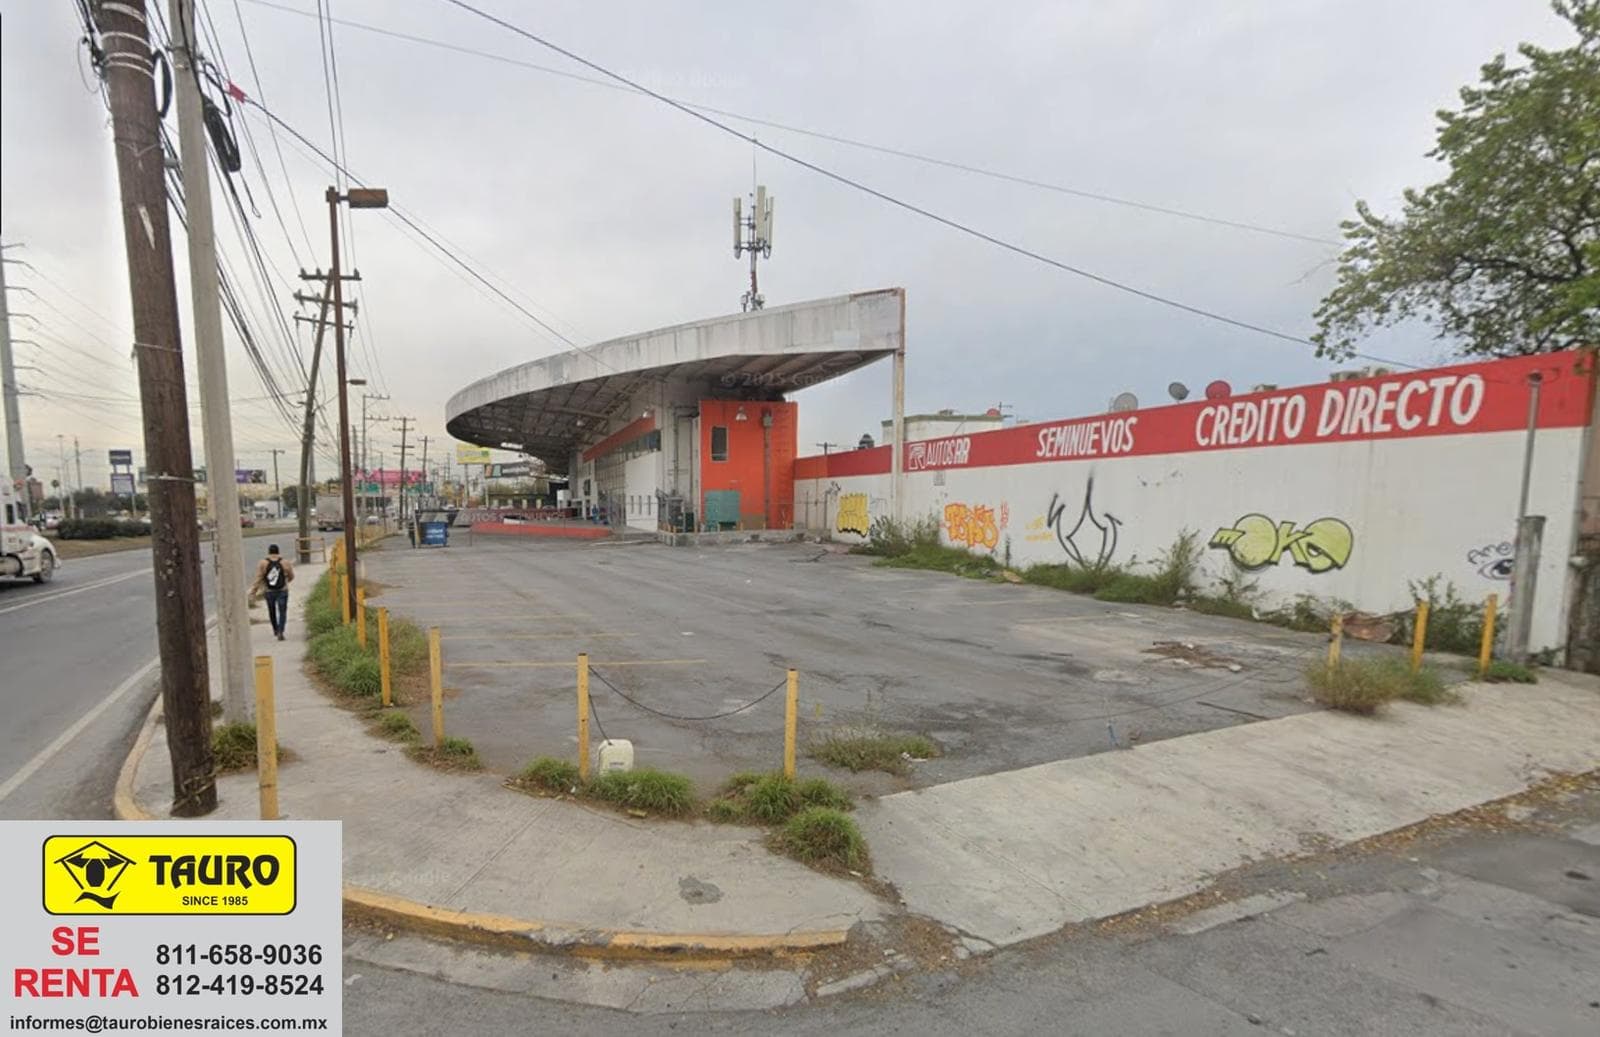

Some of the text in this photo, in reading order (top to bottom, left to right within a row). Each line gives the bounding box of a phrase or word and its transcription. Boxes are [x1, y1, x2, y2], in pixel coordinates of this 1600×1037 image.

[1036, 416, 1138, 458] SEMINUEVOS
[1195, 394, 1305, 447] CREDITO
[1316, 373, 1485, 437] DIRECTO
